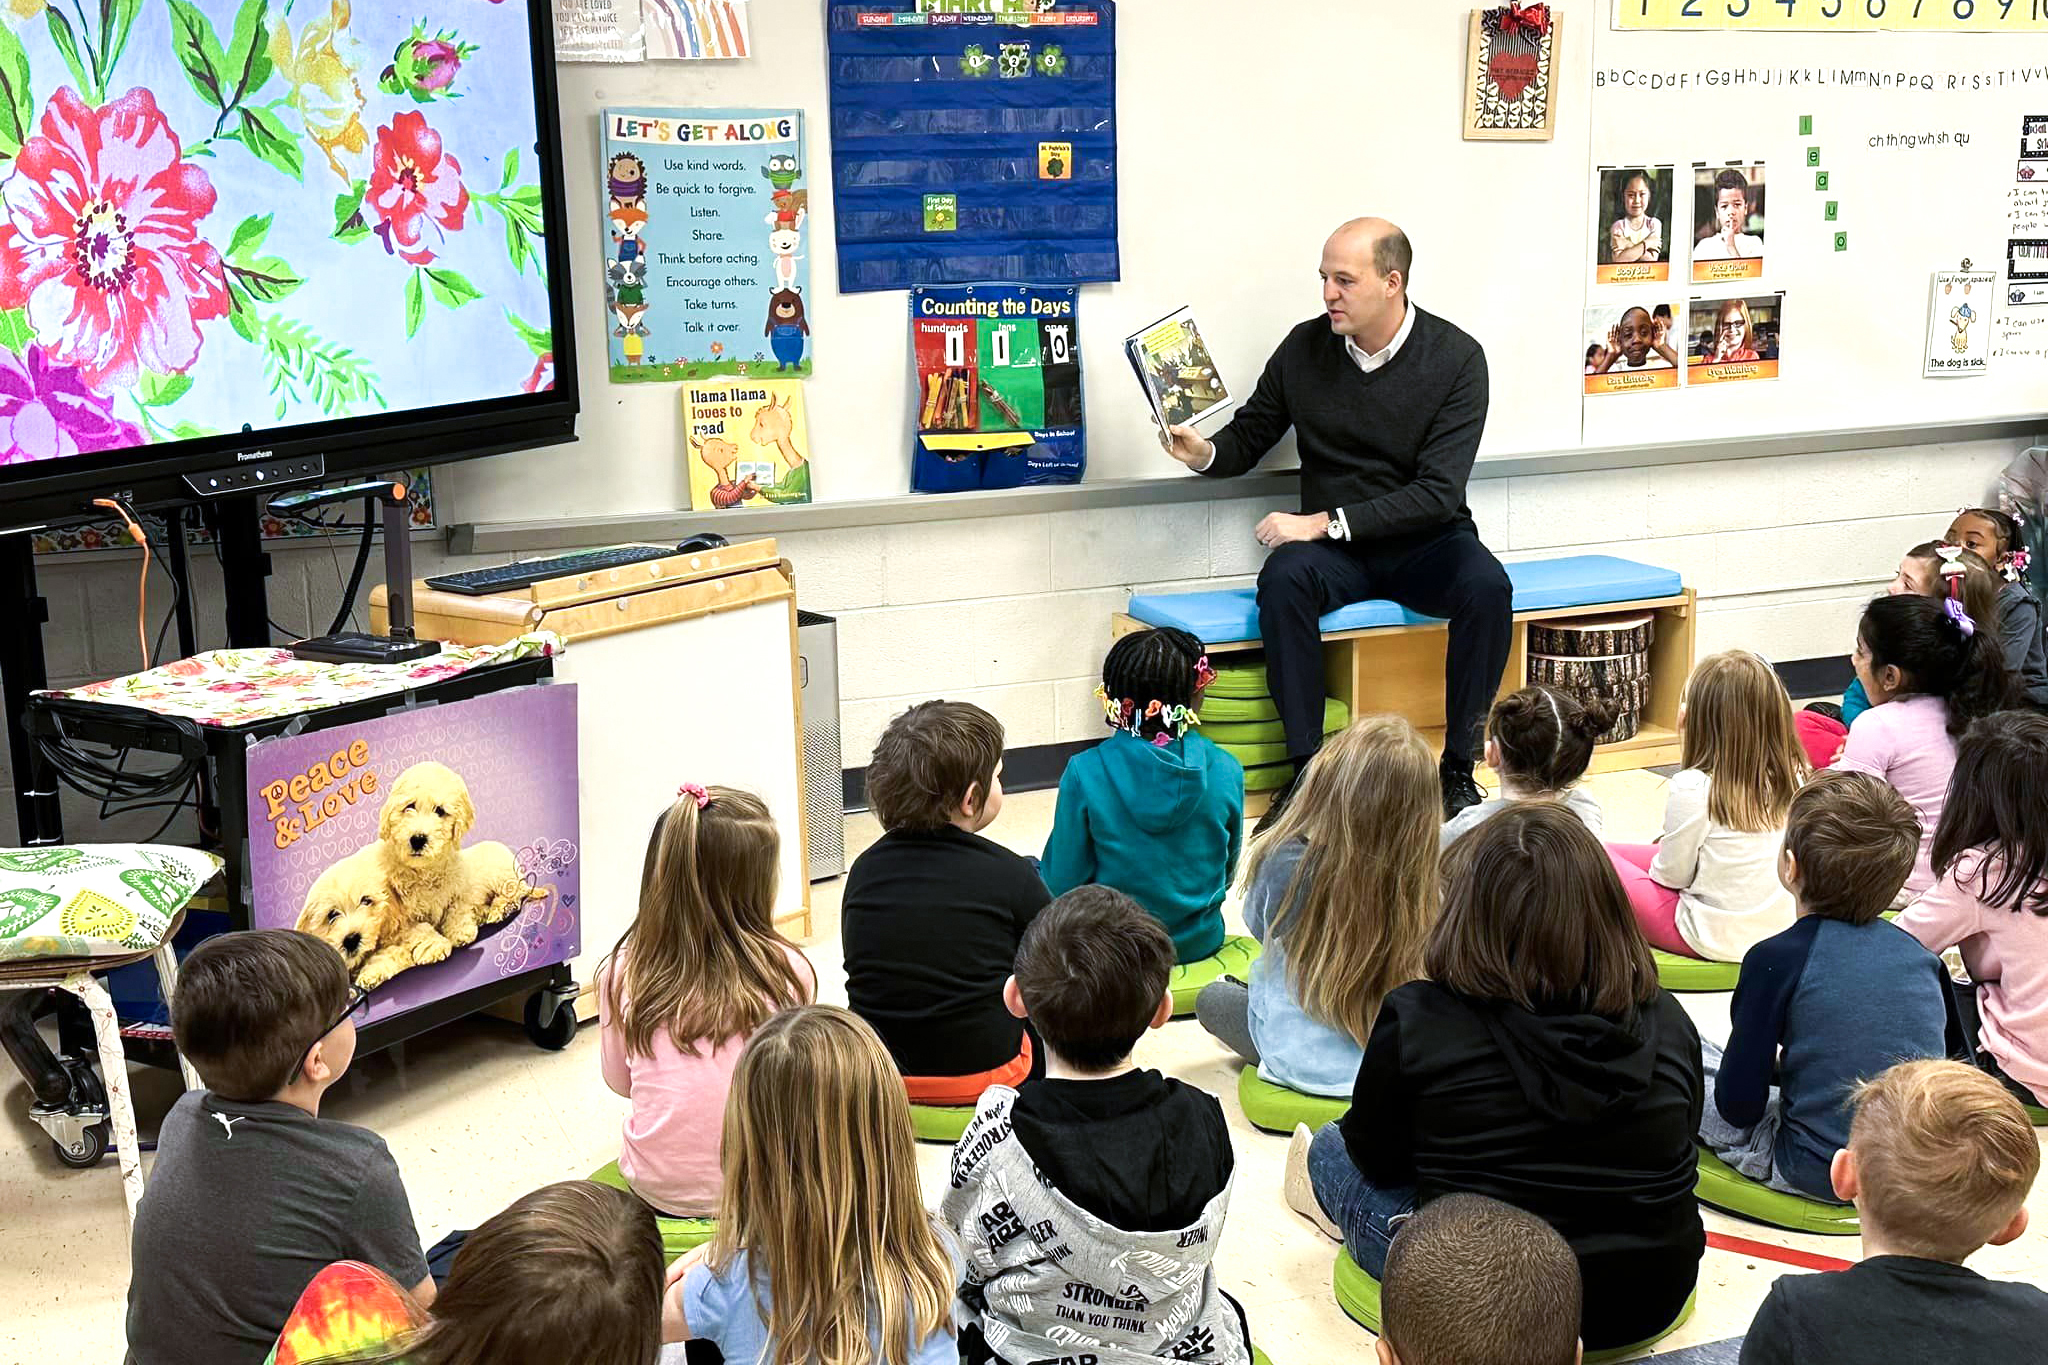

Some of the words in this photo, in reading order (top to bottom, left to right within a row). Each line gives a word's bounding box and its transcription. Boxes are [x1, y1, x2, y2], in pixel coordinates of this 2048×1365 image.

[615, 117, 671, 142] LET'S
[677, 123, 719, 142] GET
[724, 119, 792, 142] ALONG
[663, 158, 684, 171] Use
[687, 158, 709, 171] kind
[712, 158, 747, 172] words.
[656, 182, 670, 194] Be
[672, 182, 700, 197] quick
[704, 183, 715, 194] to
[718, 182, 757, 198] forgive.
[690, 205, 721, 218] Listen.
[692, 229, 725, 241] Share.
[657, 252, 686, 264] Think
[688, 252, 723, 264] before
[666, 275, 721, 290] Encourage
[724, 275, 758, 286] others.
[684, 299, 708, 310] Take
[711, 299, 738, 310] turns.
[921, 297, 999, 319] Counting
[1002, 297, 1026, 315] the
[1030, 297, 1071, 318] Days
[684, 321, 704, 333] Talk
[708, 322, 714, 333] it
[921, 322, 969, 333] hundreds
[998, 322, 1017, 332] tens
[1930, 358, 1945, 368] The
[1946, 358, 1962, 369] dog
[1962, 358, 1969, 368] is
[690, 389, 728, 404] llama
[730, 387, 767, 402] llama
[692, 406, 727, 420] loves
[730, 405, 743, 417] to
[693, 420, 725, 436] read
[237, 449, 273, 462] Promethean
[259, 738, 370, 822] Peace
[274, 816, 302, 850] &
[297, 770, 379, 834] Love
[1055, 1304, 1086, 1323] THAN
[1088, 1312, 1110, 1328] YOU
[1112, 1315, 1148, 1334] THINK
